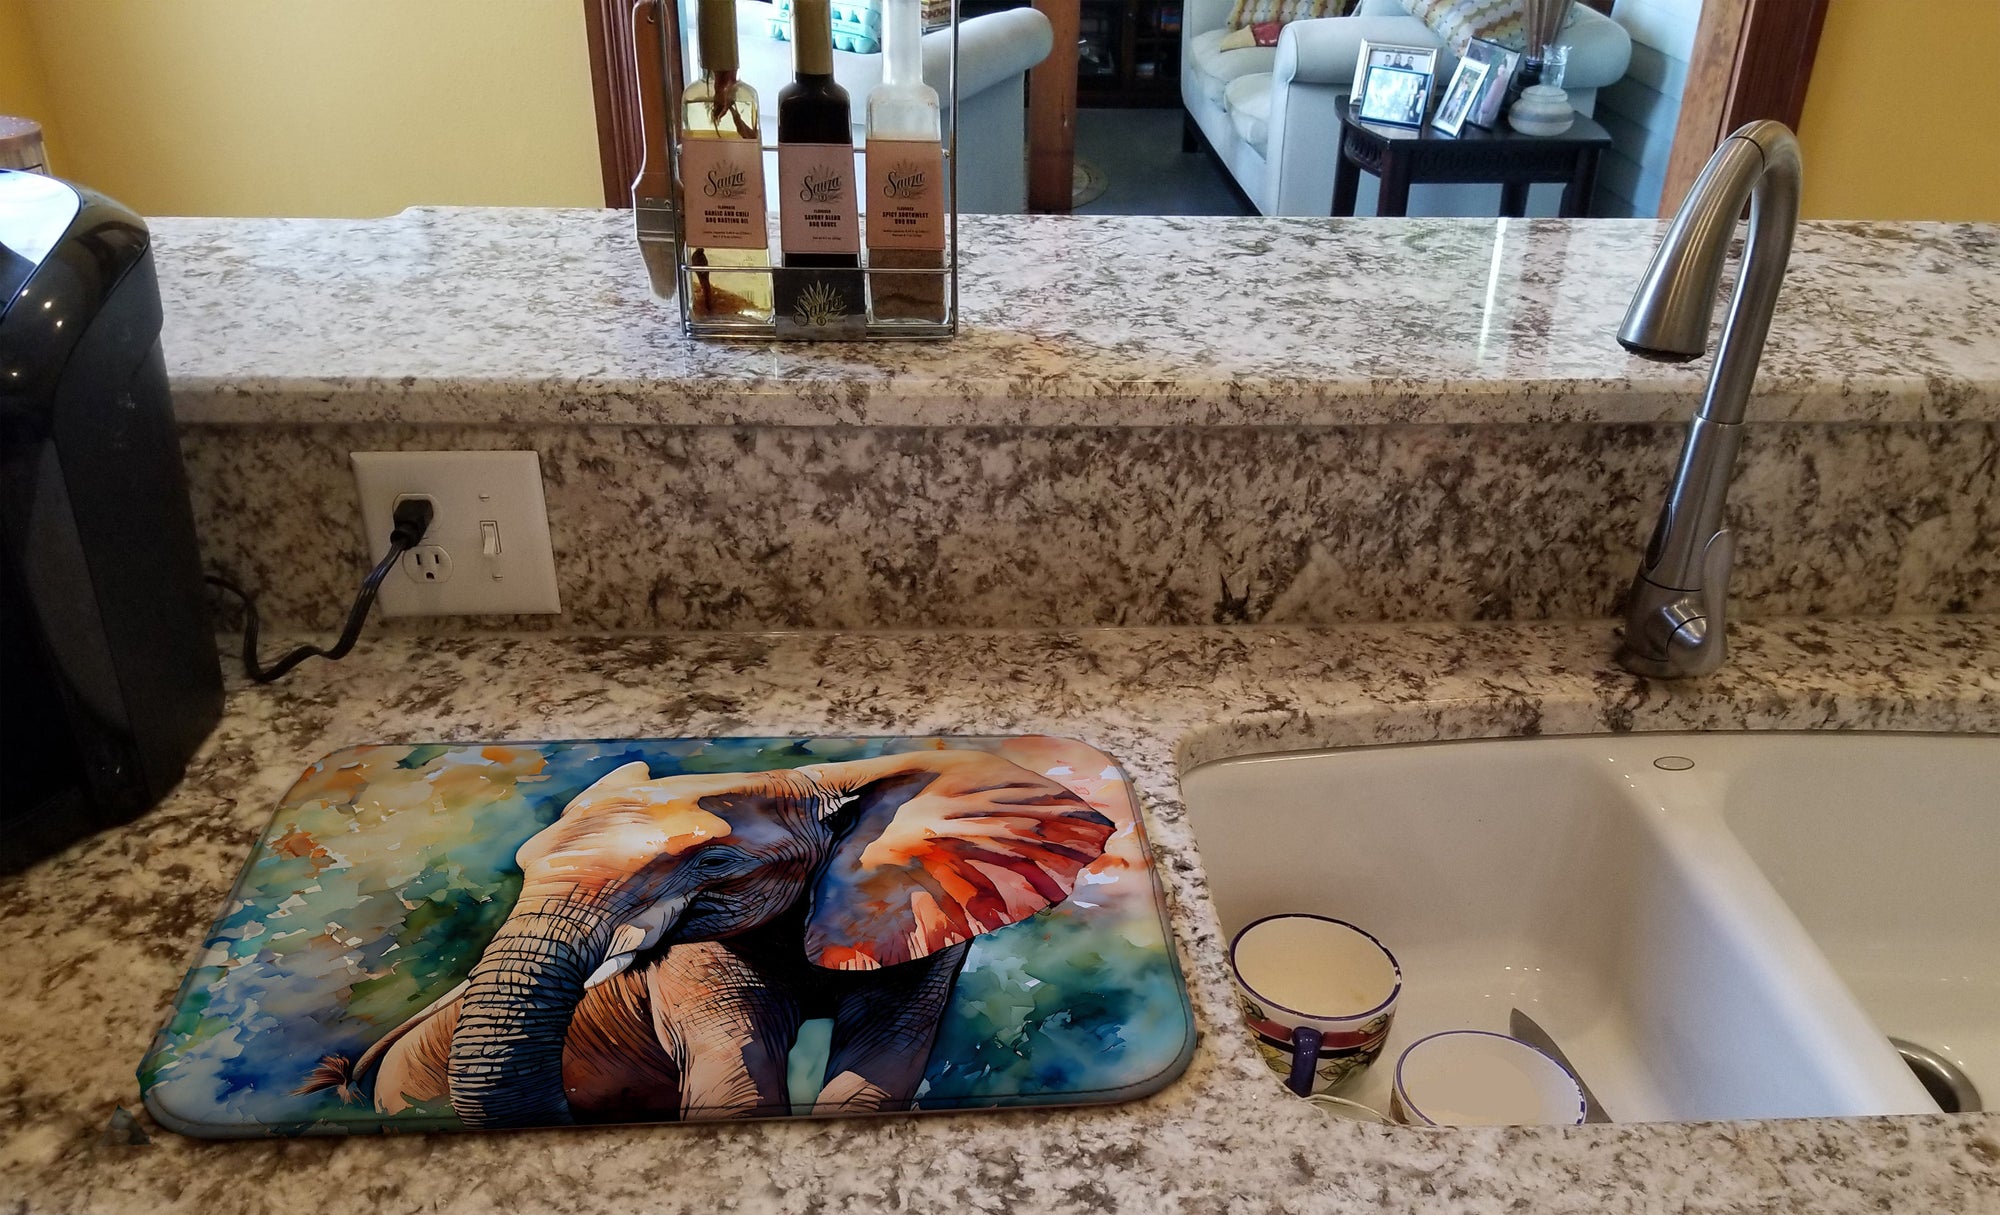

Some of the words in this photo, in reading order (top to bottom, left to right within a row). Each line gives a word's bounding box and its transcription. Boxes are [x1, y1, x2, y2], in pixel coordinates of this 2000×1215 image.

[704, 170, 745, 197] Sauza
[800, 175, 841, 202] Sauza
[884, 171, 925, 198] Sauza
[793, 293, 843, 326] Sauza
